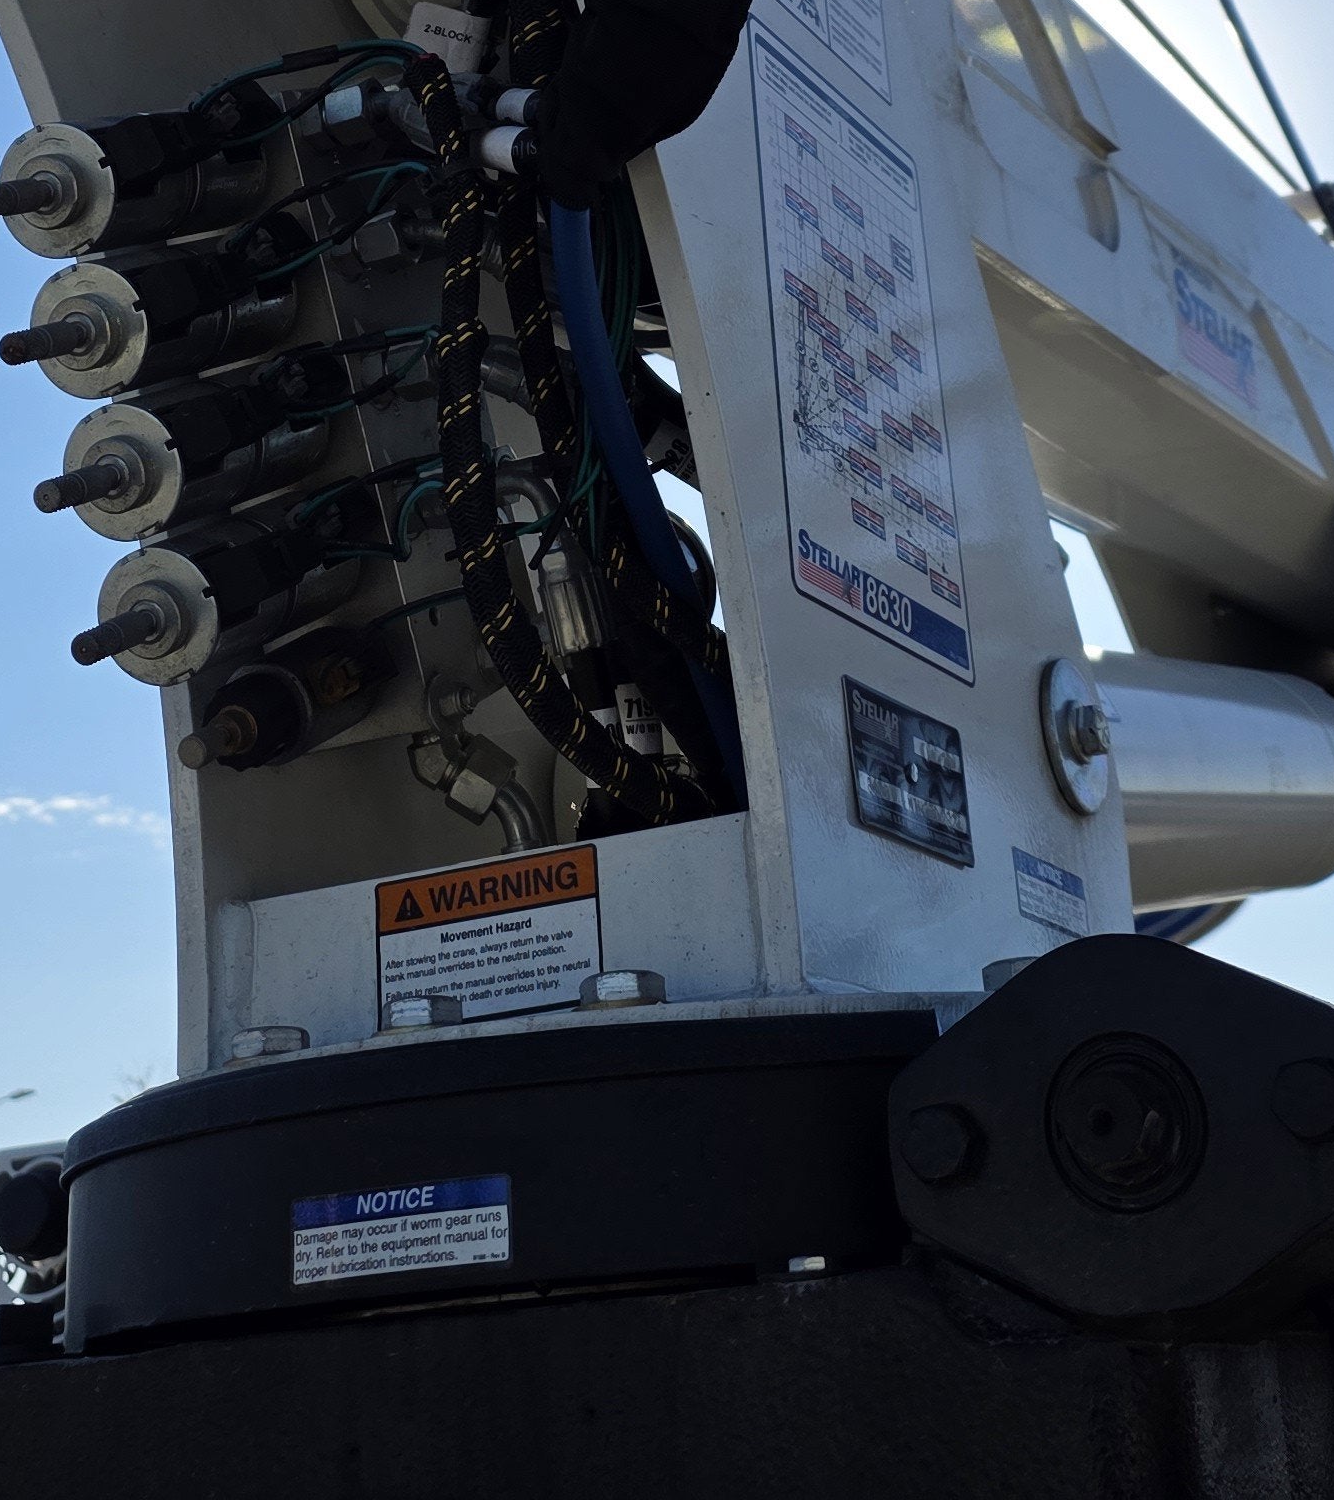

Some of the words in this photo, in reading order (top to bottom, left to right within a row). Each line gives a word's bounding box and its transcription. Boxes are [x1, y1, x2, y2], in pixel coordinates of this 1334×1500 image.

[423, 23, 473, 45] 2-BLOCK
[798, 528, 861, 588] STELLAR
[867, 576, 912, 634] 8630
[852, 689, 899, 731] STELLAR
[428, 861, 578, 913] WARNING
[440, 924, 493, 944] Movement
[496, 917, 532, 934] Hazard
[385, 959, 405, 971] After
[406, 953, 436, 966] stowing
[438, 951, 451, 961] the
[480, 940, 508, 954] always
[510, 936, 534, 949] return
[536, 933, 549, 944] the
[551, 930, 573, 942] valve
[385, 972, 405, 984] bank
[407, 966, 436, 980] manual
[438, 959, 475, 975] overrides
[477, 957, 485, 968] to
[487, 955, 500, 966] the
[502, 949, 530, 963] neutral
[425, 984, 449, 995] return
[451, 981, 464, 992] the
[465, 975, 496, 989] manual
[497, 968, 535, 983] overrides
[537, 966, 545, 977] to
[547, 963, 560, 974] the
[563, 958, 591, 971] neutral
[469, 987, 493, 1001] death
[494, 988, 504, 996] or
[505, 983, 535, 995] serious
[356, 1185, 435, 1215] NOTICE
[295, 1231, 338, 1246] Damage
[341, 1228, 364, 1241] may
[367, 1223, 398, 1236] occur
[401, 1218, 408, 1231] if
[410, 1217, 442, 1231] worm
[445, 1214, 473, 1230] gear
[476, 1211, 502, 1222] runs
[295, 1249, 313, 1265] dry.
[317, 1244, 345, 1259] Refer
[347, 1243, 358, 1256] to
[361, 1241, 378, 1253] the
[381, 1233, 441, 1252] equipment
[444, 1226, 488, 1244] manual
[491, 1225, 508, 1239] for
[295, 1264, 329, 1282] proper
[331, 1257, 386, 1275] lubrication
[389, 1250, 458, 1267] instructions.
